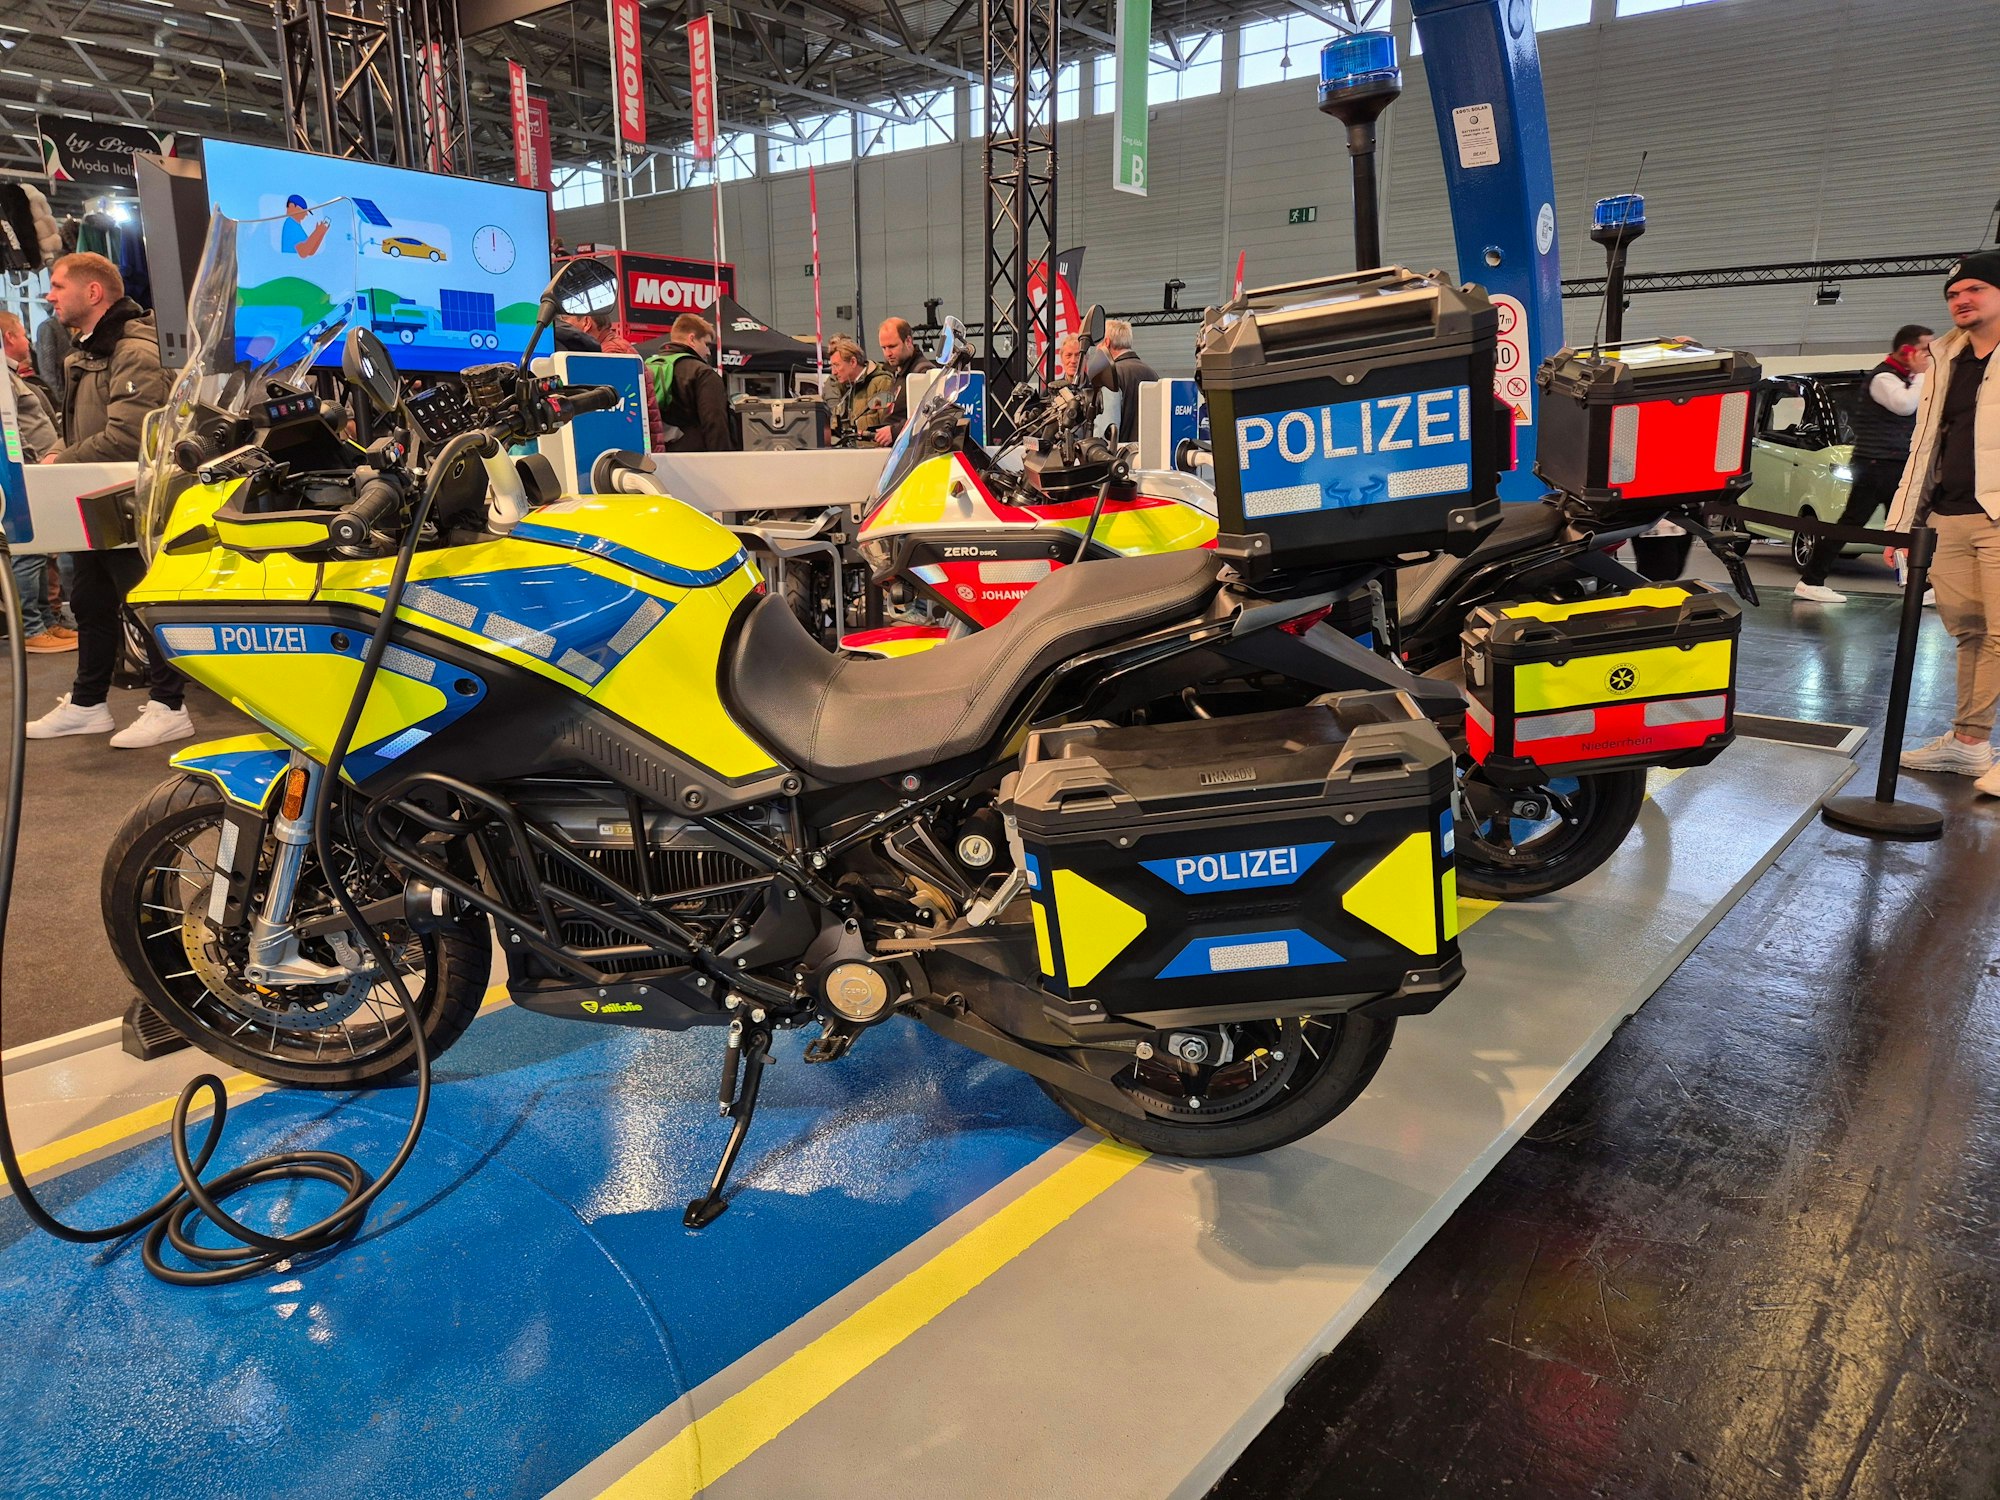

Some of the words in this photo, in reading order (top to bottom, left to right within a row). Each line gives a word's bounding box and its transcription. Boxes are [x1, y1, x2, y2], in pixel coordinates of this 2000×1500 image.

[619, 4, 639, 132] MOTUL
[65, 132, 94, 153] by
[624, 142, 645, 155] SHOP
[1132, 154, 1144, 187] B
[722, 354, 752, 366] 300V
[1175, 405, 1192, 416] BEAM
[1236, 387, 1470, 470] POLIZEI
[944, 547, 979, 557] ZERO
[221, 627, 307, 652] POLIZEI
[1582, 736, 1653, 752] Niederrhein
[1176, 847, 1298, 885] POLIZEI
